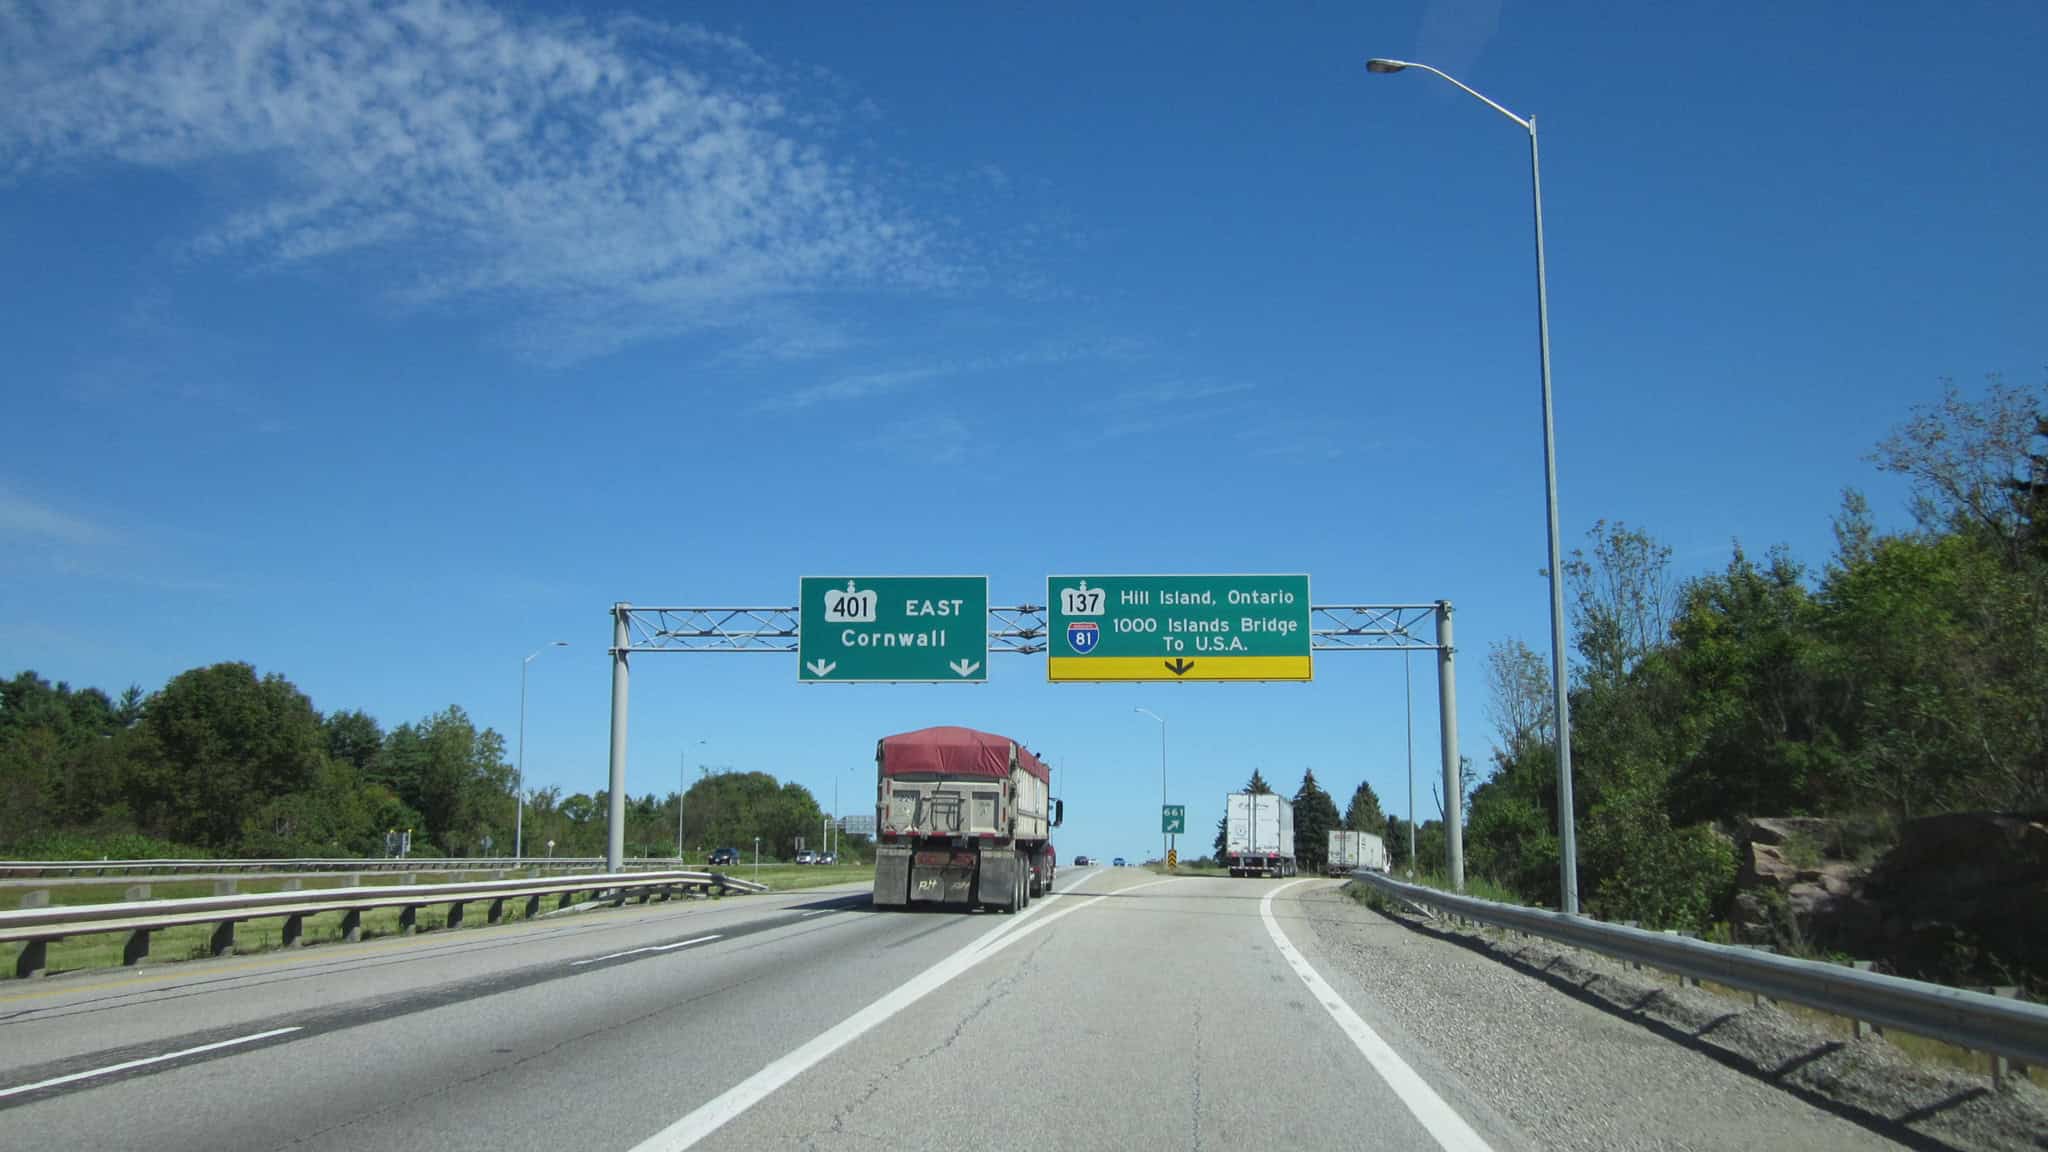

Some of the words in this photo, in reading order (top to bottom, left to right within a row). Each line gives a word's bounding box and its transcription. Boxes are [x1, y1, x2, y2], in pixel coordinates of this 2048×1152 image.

[832, 597, 868, 617] 401
[1068, 593, 1099, 612] 137
[1120, 590, 1149, 605] Hill
[1160, 590, 1217, 607] Island,
[1228, 589, 1294, 605] Ontario
[905, 600, 963, 616] EAST
[1113, 618, 1157, 633] 1000
[1168, 618, 1230, 633] Islands
[1241, 617, 1297, 636] Bridge
[841, 629, 945, 647] Cornwall
[1075, 632, 1091, 646] 81
[1163, 637, 1184, 651] To
[1196, 637, 1248, 651] U.S.A.
[1164, 808, 1183, 817] 661
